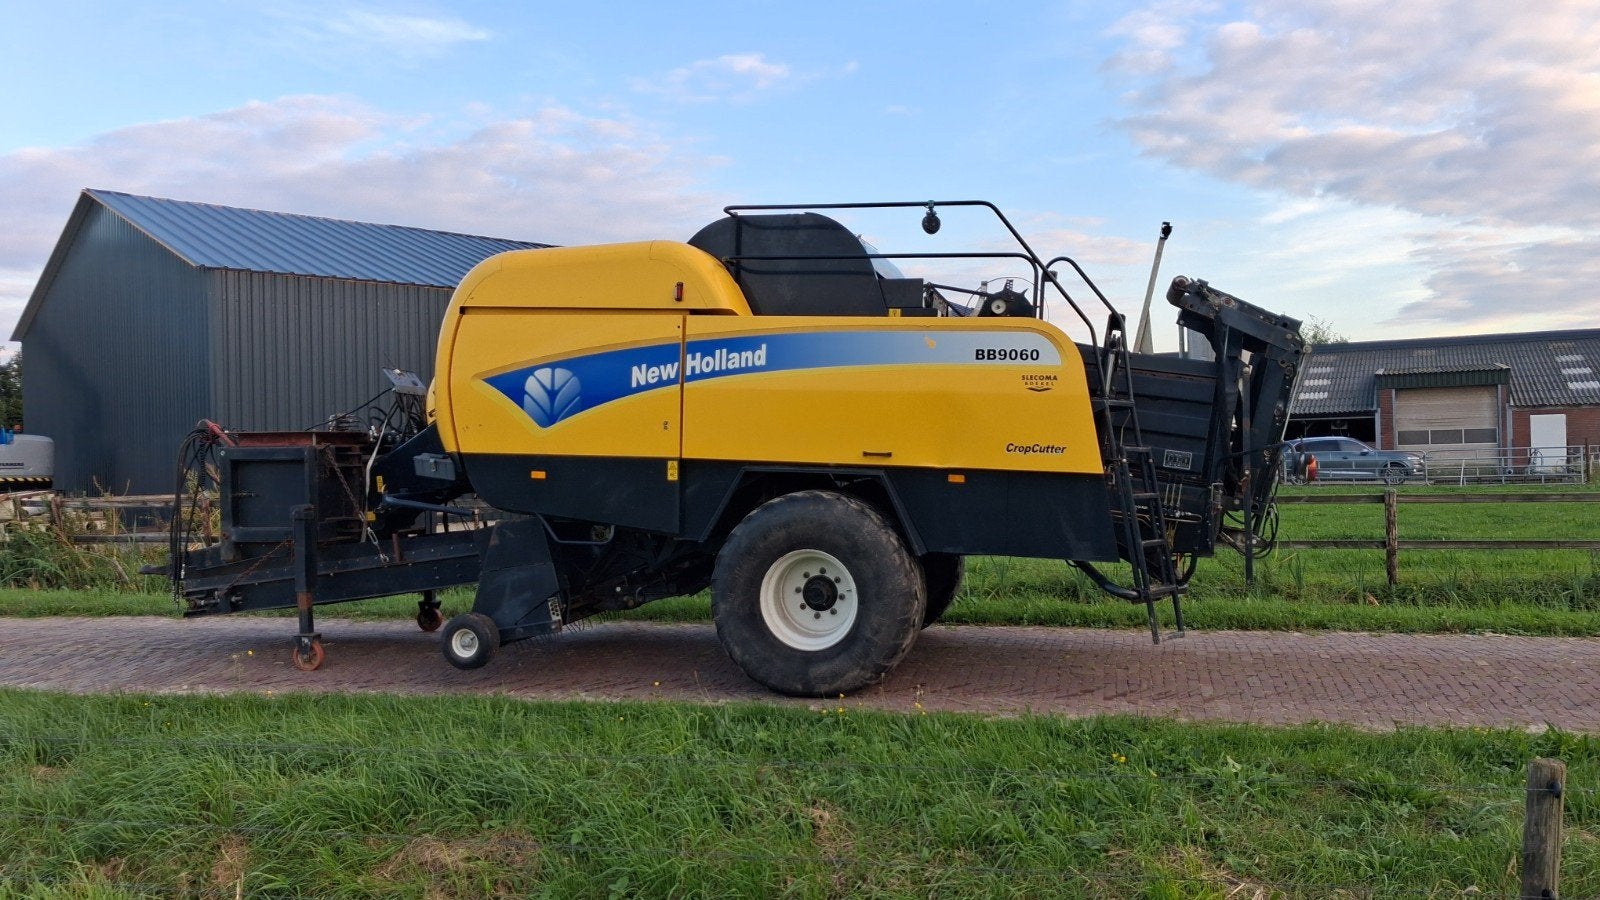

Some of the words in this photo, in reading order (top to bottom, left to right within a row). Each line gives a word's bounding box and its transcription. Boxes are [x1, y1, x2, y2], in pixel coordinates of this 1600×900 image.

[975, 348, 1040, 361] BB9060
[631, 361, 679, 388] New
[686, 343, 767, 376] Holland
[1006, 442, 1067, 455] CropCutter
